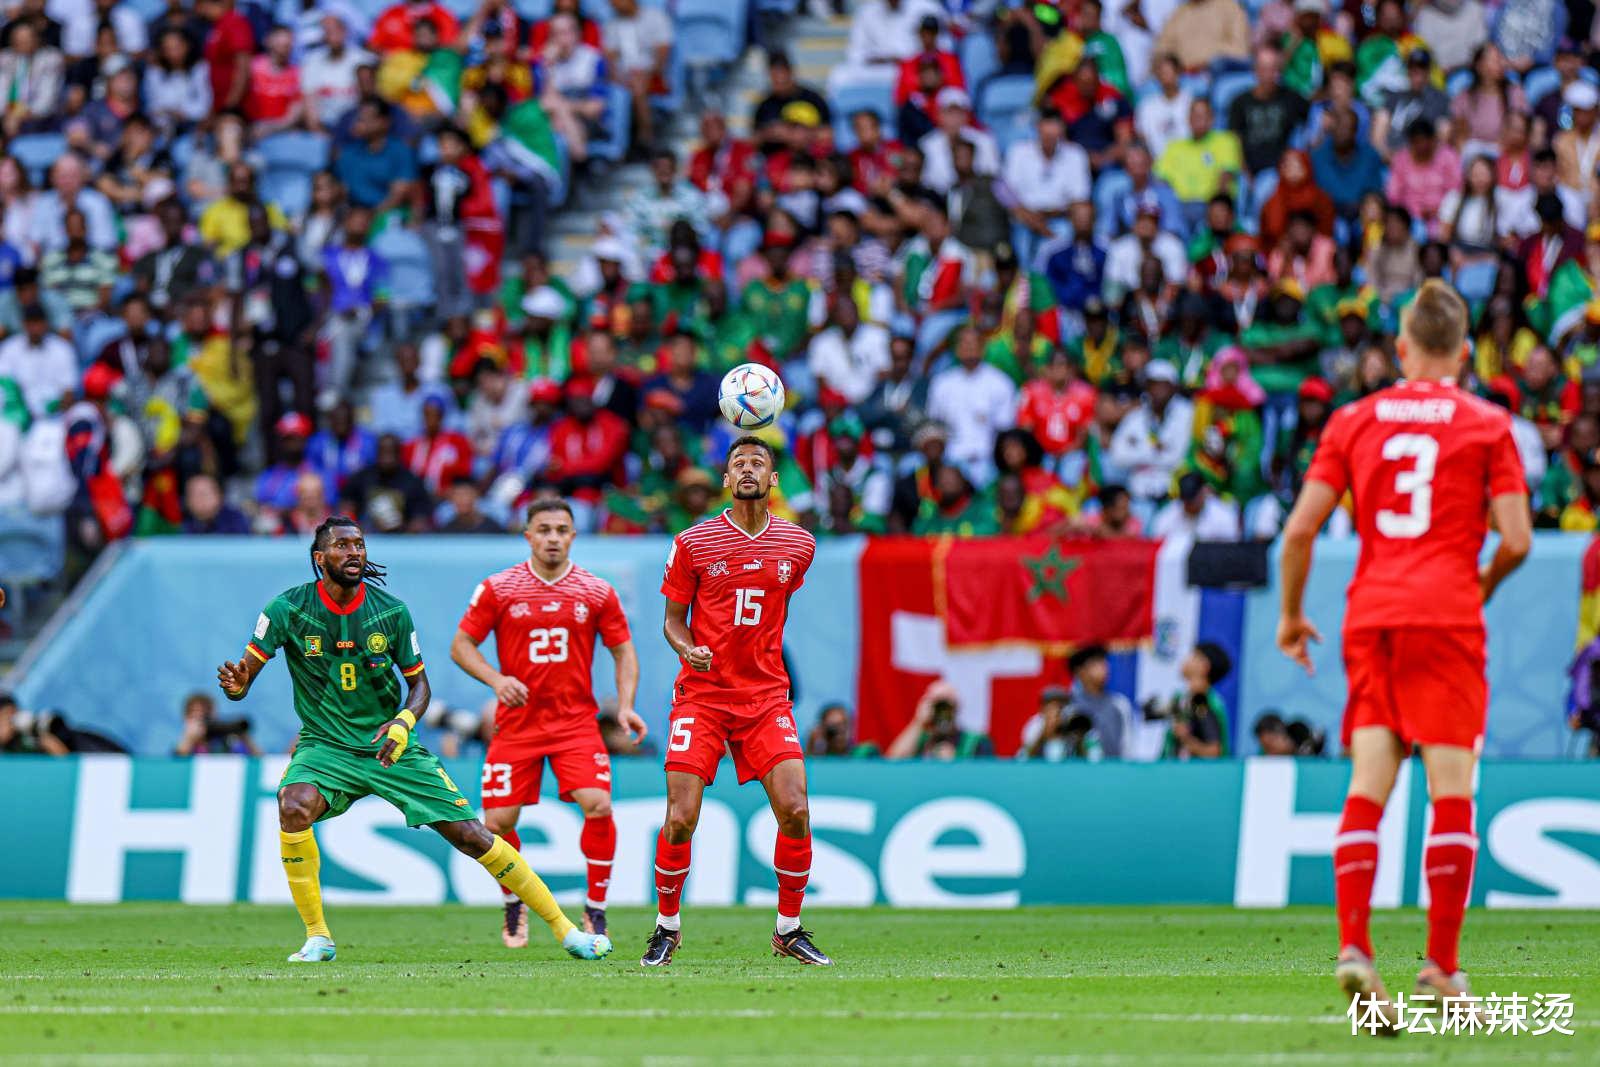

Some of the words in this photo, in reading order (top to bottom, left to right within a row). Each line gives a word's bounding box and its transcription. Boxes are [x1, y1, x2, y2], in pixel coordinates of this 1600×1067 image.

[1376, 433, 1439, 538] 3
[733, 588, 765, 626] 15
[529, 627, 569, 664] 23
[340, 662, 357, 691] 8
[481, 763, 512, 797] 23
